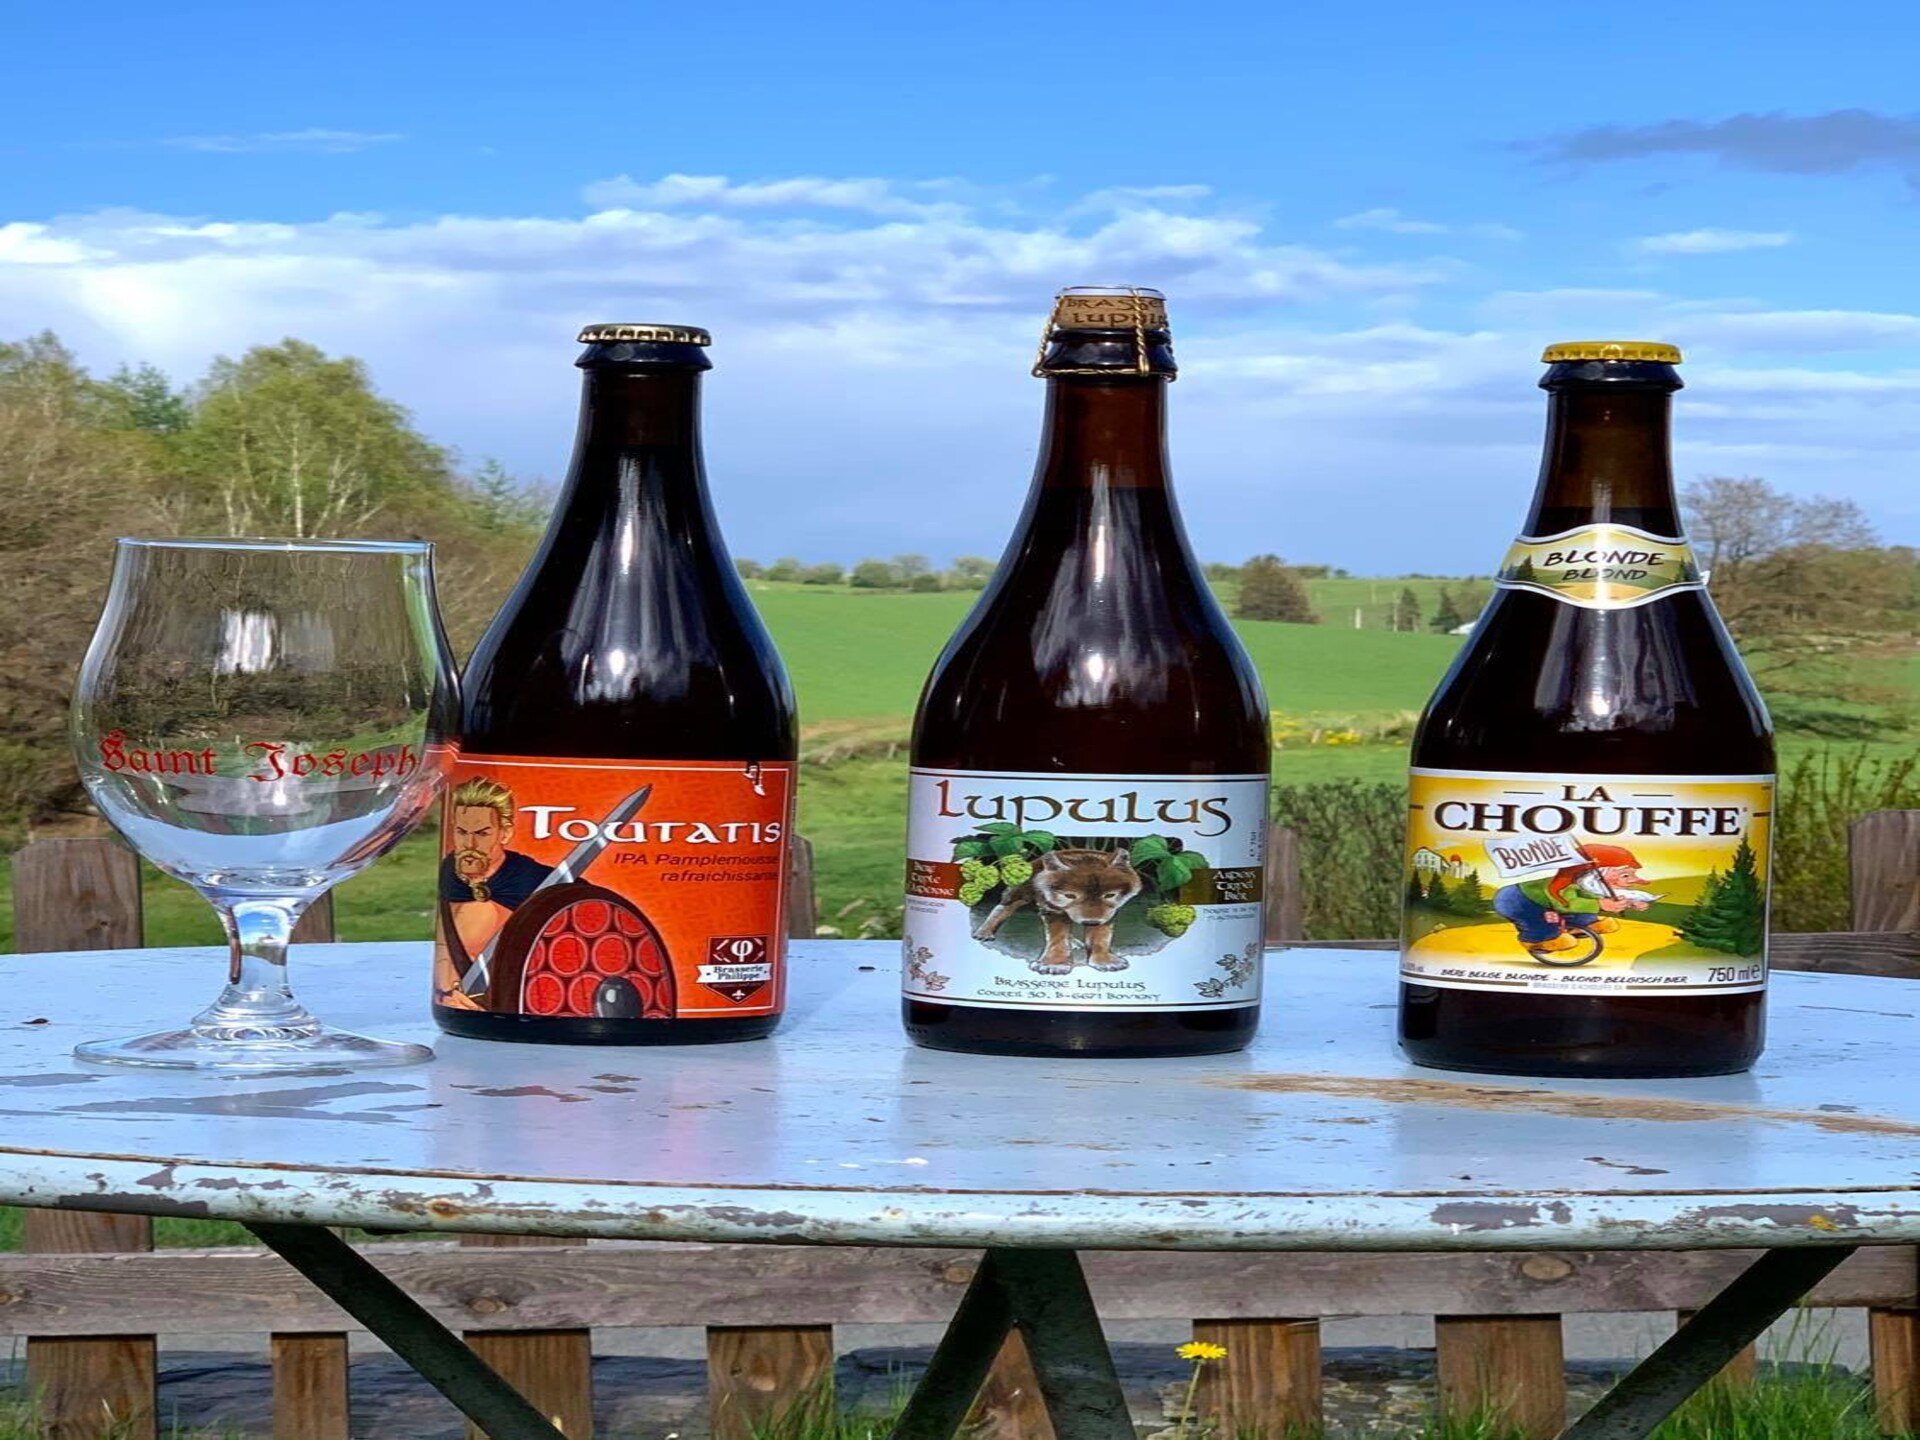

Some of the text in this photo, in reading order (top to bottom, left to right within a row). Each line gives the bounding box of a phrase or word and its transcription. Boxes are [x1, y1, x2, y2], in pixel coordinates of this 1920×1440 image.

[1543, 550, 1665, 566] BLONDE
[1562, 568, 1648, 581] BLOND
[100, 729, 418, 783] Saint Joseph
[1562, 785, 1614, 802] LA
[1434, 801, 1741, 836] CHOUFFE
[614, 853, 648, 865] IPA
[1492, 836, 1568, 870] BLONDE
[1505, 972, 1550, 981] BLONDE
[1561, 975, 1602, 983] BLOND
[1604, 975, 1663, 984] BELGISCH
[1664, 976, 1688, 984] BIER
[1708, 967, 1735, 982] 750
